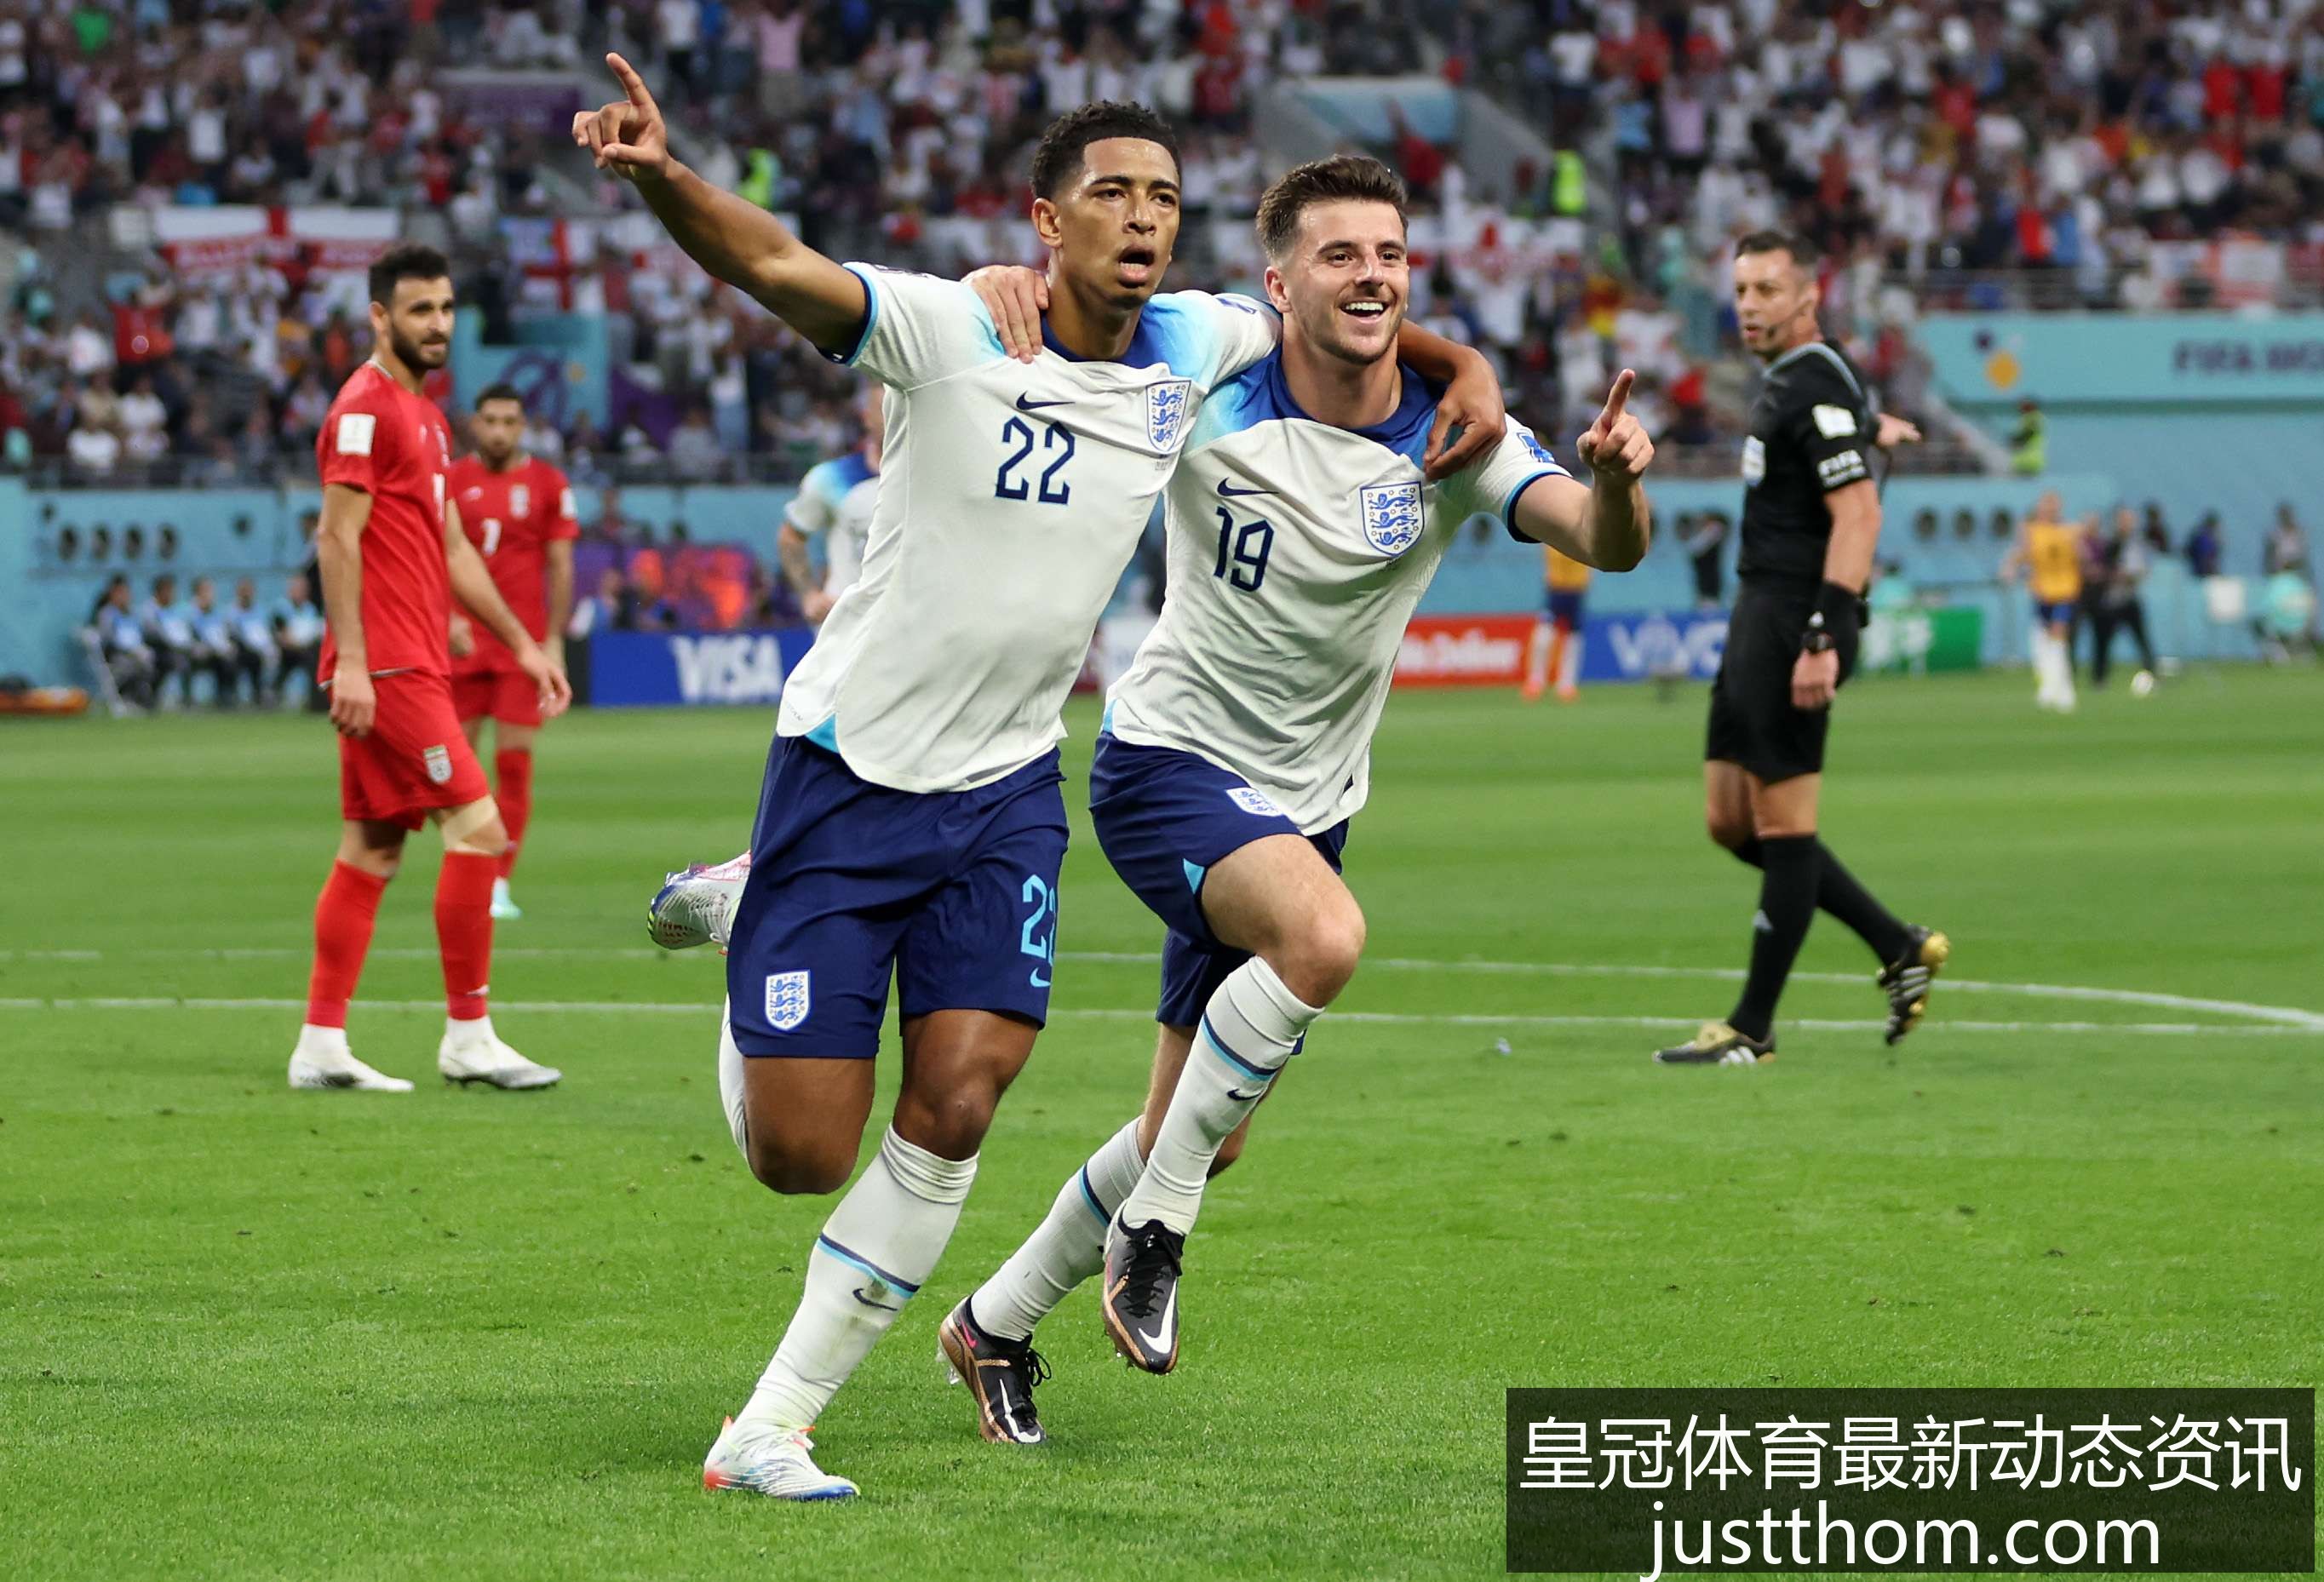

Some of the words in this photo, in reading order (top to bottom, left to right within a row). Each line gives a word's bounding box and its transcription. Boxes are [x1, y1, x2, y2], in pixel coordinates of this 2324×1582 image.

[995, 416, 1076, 506] 22
[1213, 506, 1275, 593] 19
[671, 634, 783, 700] VISA
